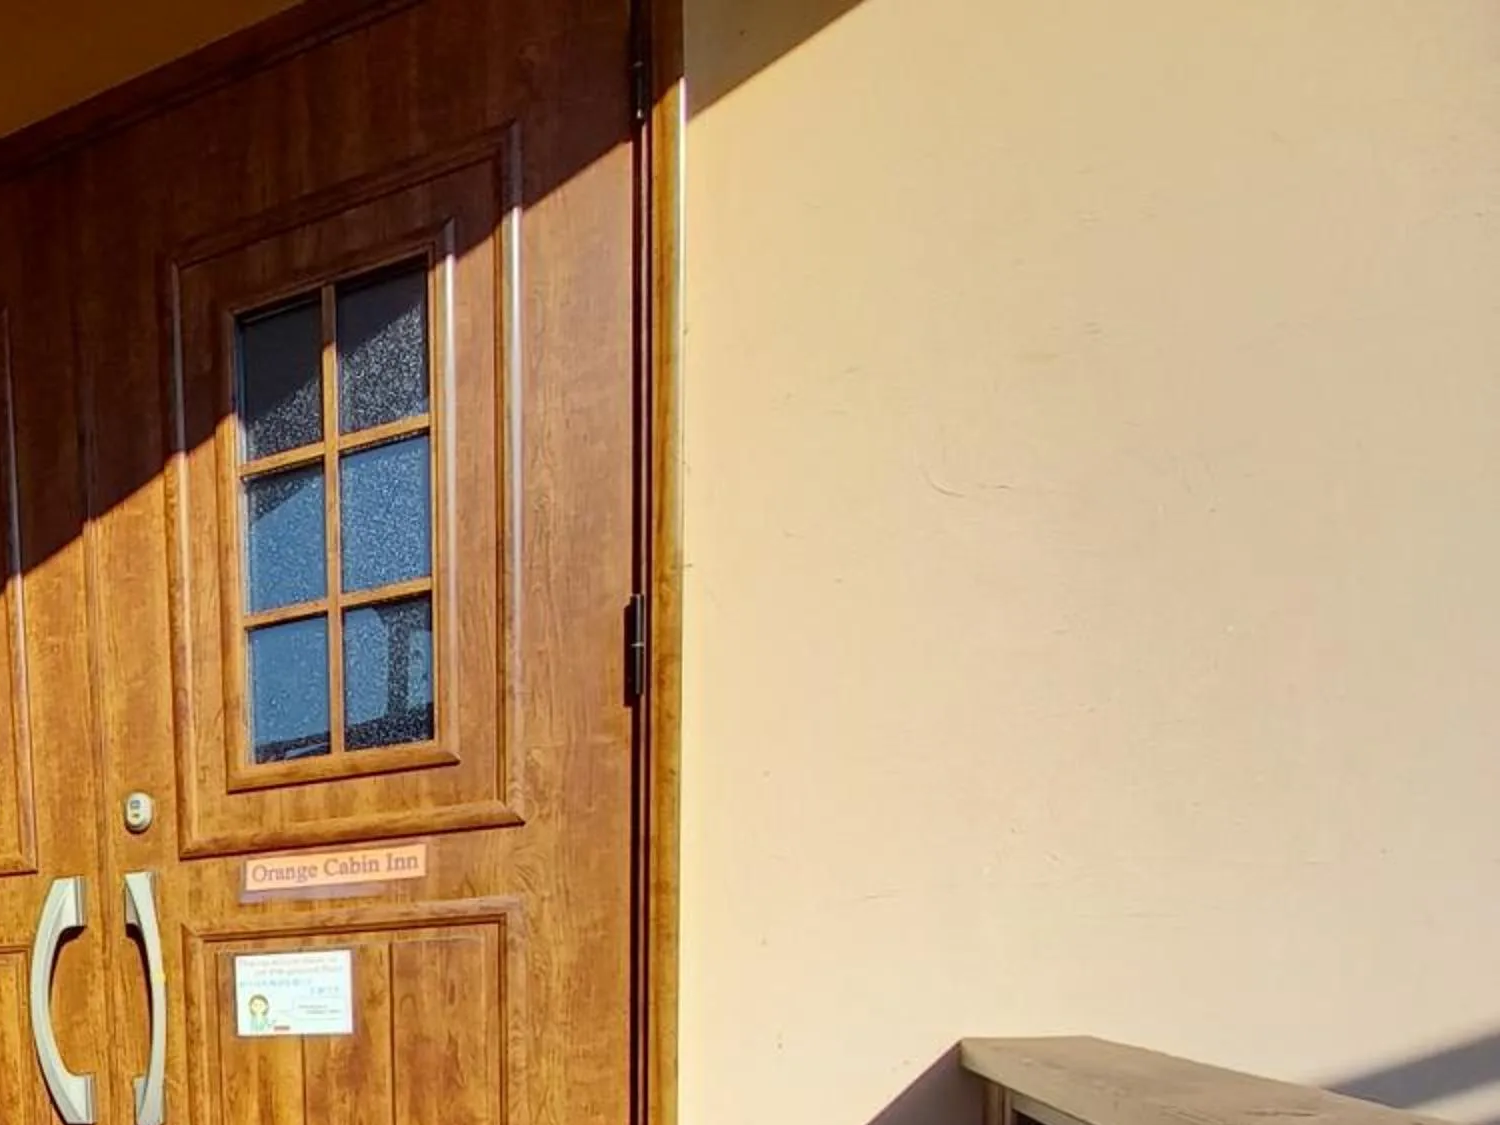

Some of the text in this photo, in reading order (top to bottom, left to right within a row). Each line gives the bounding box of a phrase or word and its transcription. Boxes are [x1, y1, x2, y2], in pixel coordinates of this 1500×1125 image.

[252, 853, 419, 883] Orange Cabin Inn
